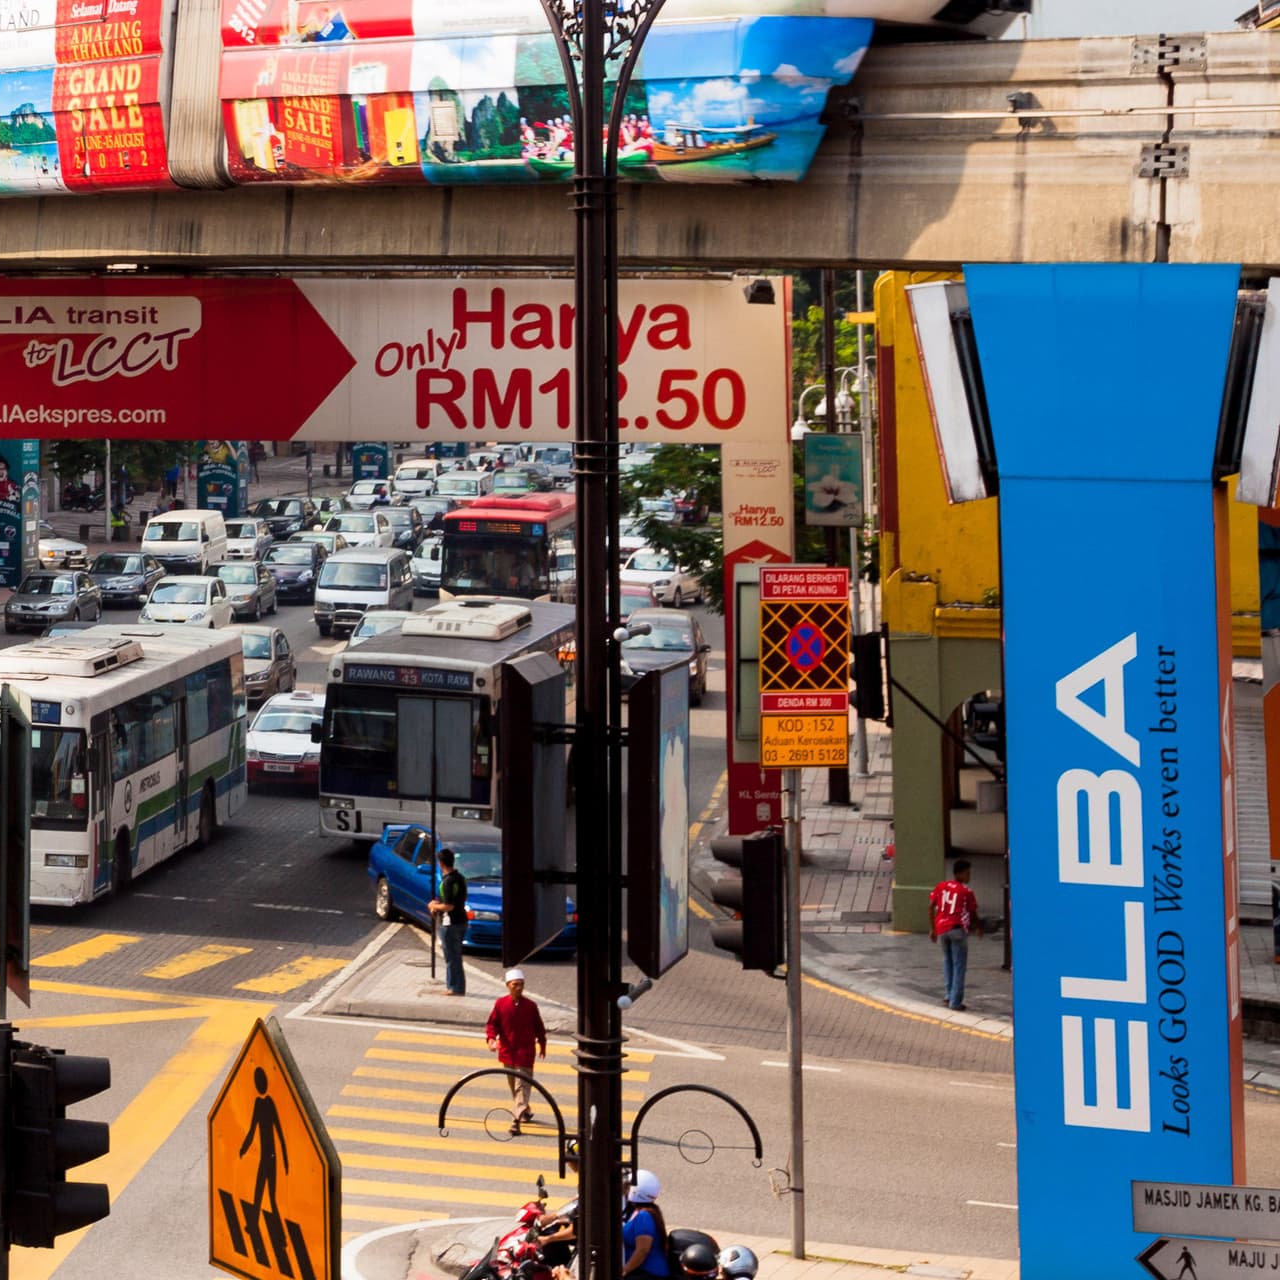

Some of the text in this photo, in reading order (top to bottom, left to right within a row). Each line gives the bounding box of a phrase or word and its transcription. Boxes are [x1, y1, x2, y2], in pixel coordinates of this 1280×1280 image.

[71, 21, 142, 45] AMAZING
[71, 37, 143, 61] THAILAND
[69, 64, 142, 97] GRAND
[67, 94, 144, 133] SALE
[283, 95, 331, 114] GRAND
[284, 108, 333, 138] SALE
[66, 305, 159, 325] transit
[27, 328, 191, 383] to LCCT
[375, 328, 462, 378] Only
[415, 368, 747, 430] RM1.50
[734, 516, 784, 527] RM12.50
[739, 504, 776, 519] Hanya
[765, 573, 845, 584] DILARANG BERHENTI
[772, 584, 838, 595] DI PETAK KUNING
[349, 668, 396, 682] RAWANG
[421, 673, 445, 684] KOTA
[446, 675, 470, 687] RAYA
[778, 697, 804, 708] DENDA
[806, 697, 818, 707] RM
[777, 719, 834, 732] KOD 152
[764, 735, 846, 746] Aduan Kerosakan
[764, 749, 845, 761] 03 2691 5128
[754, 789, 782, 799] Sentr
[1056, 632, 1152, 1133] ELBA
[1149, 644, 1192, 1139] Looks GOOD Works even better
[941, 889, 958, 914] 14
[1144, 1188, 1191, 1208] MASJID
[1196, 1192, 1239, 1210] JAMEK
[1245, 1194, 1264, 1212] KG.
[1228, 1249, 1266, 1269] MAJU
